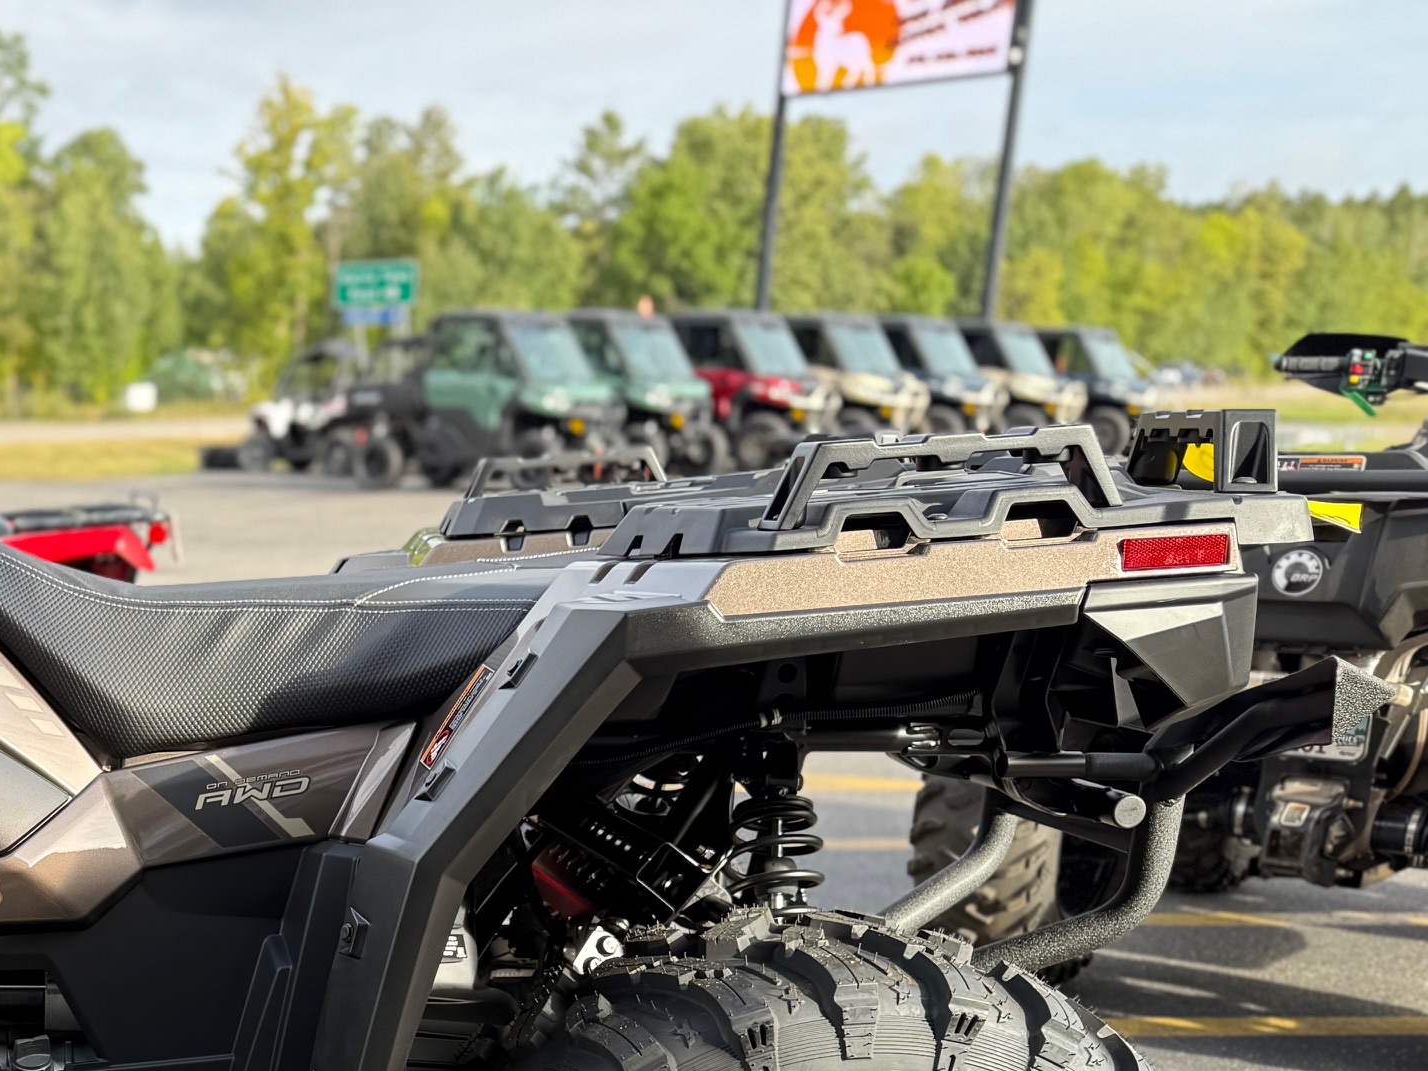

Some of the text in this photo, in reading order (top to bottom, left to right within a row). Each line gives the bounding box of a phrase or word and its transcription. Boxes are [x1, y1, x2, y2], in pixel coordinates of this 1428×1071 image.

[1290, 573, 1319, 582] BRP
[235, 769, 301, 785] DEMAND
[194, 775, 311, 811] AWD
